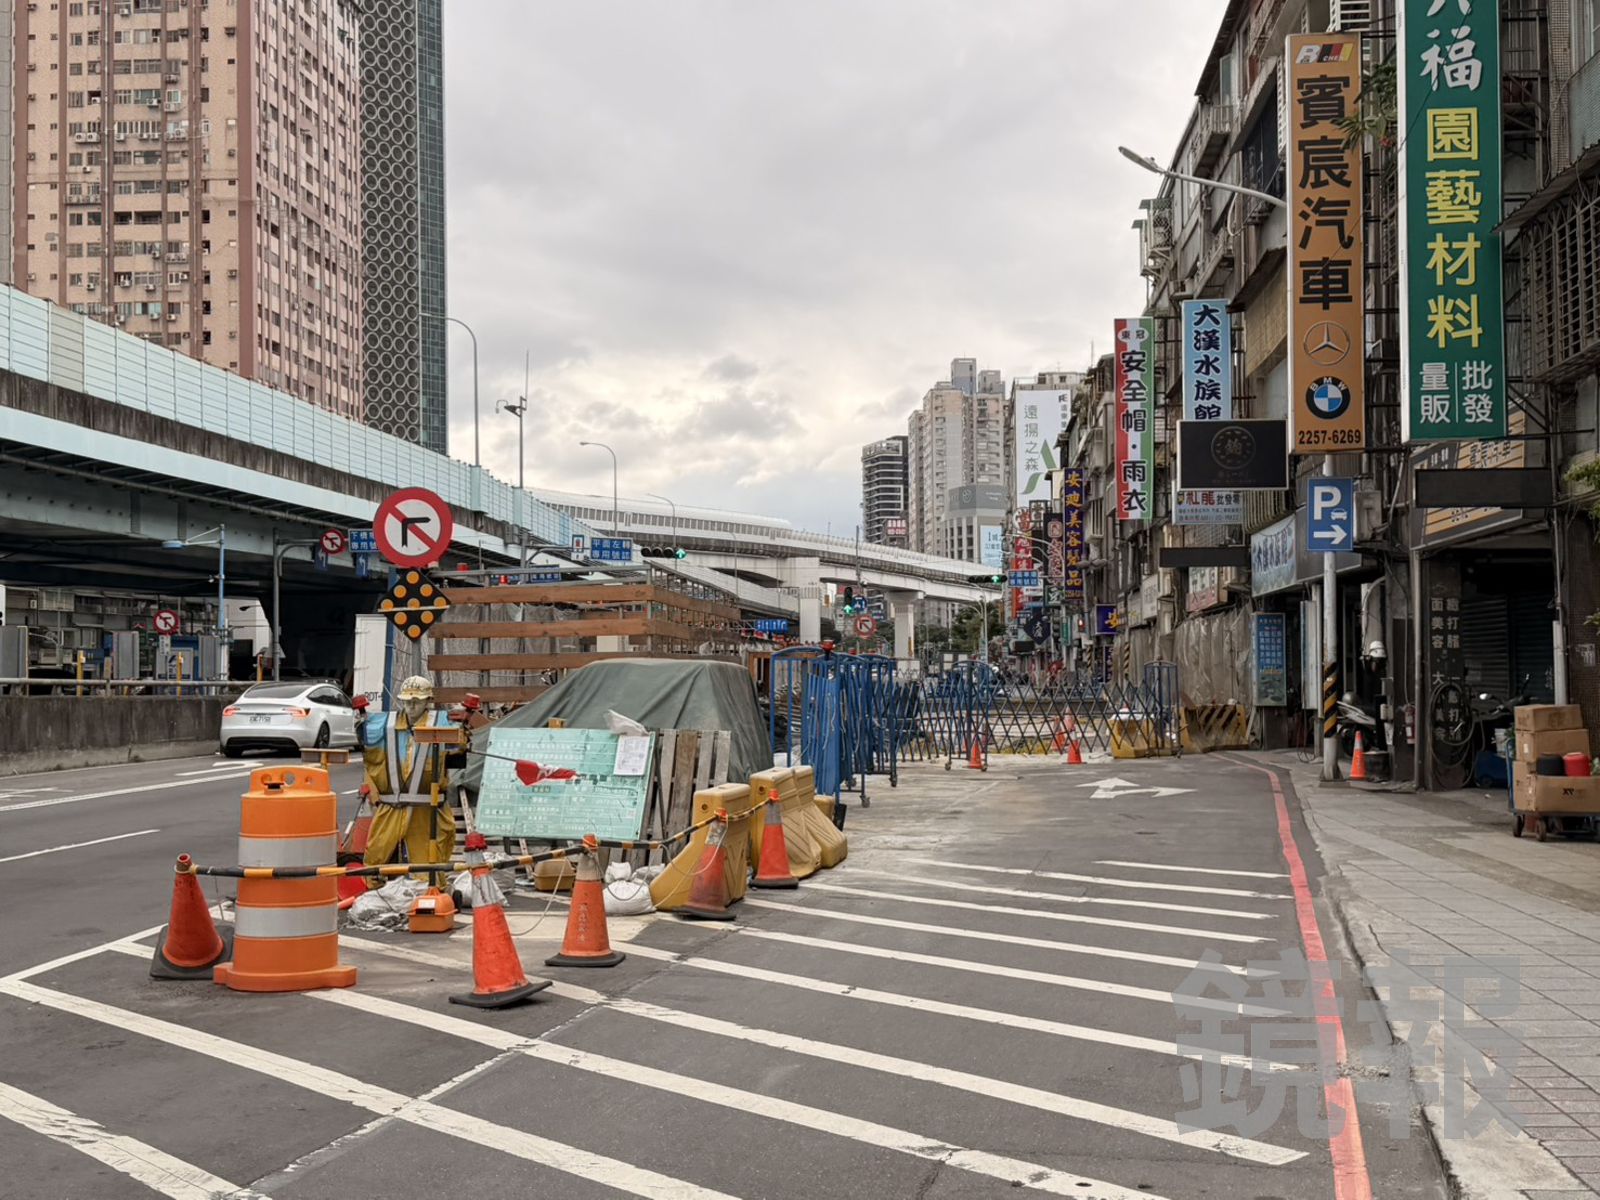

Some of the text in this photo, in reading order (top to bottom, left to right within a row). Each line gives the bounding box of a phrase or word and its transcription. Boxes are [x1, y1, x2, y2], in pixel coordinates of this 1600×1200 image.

[1296, 74, 1354, 311] 賓宸汽車
[1425, 106, 1483, 349] 園藝材料
[1193, 304, 1222, 419] 大漢水族館
[1310, 376, 1347, 392] BMW
[1419, 362, 1451, 424] 量販
[1462, 360, 1494, 424] 批發
[1024, 404, 1039, 472] 遠揚之森
[1298, 429, 1362, 445] 2257-6269
[1313, 486, 1342, 520] P
[591, 538, 632, 549] 平面左轉
